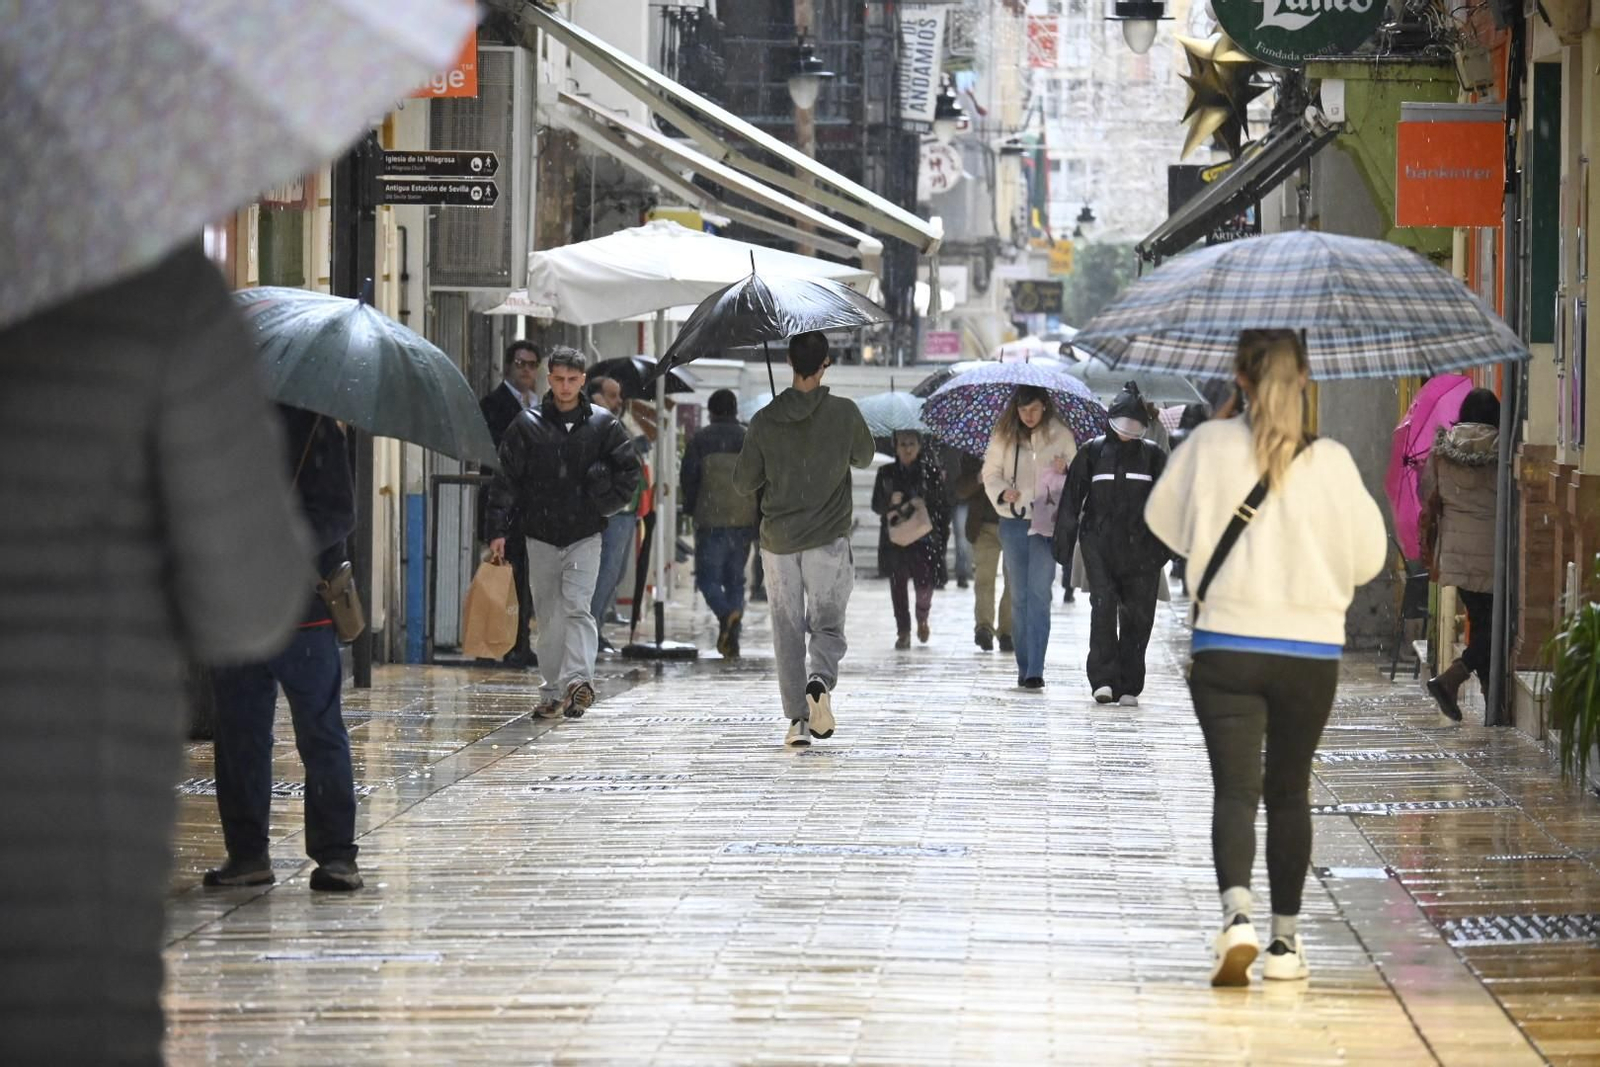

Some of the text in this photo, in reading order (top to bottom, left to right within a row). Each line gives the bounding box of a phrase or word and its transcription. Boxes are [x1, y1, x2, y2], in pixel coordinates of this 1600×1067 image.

[1255, 41, 1300, 61] Fundada
[909, 18, 938, 113] ANDAMIOS
[385, 155, 456, 165] Iglesia de la Milagrosa
[1405, 165, 1492, 179] bankinter
[385, 184, 470, 193] Antigua Estación de Sevilla
